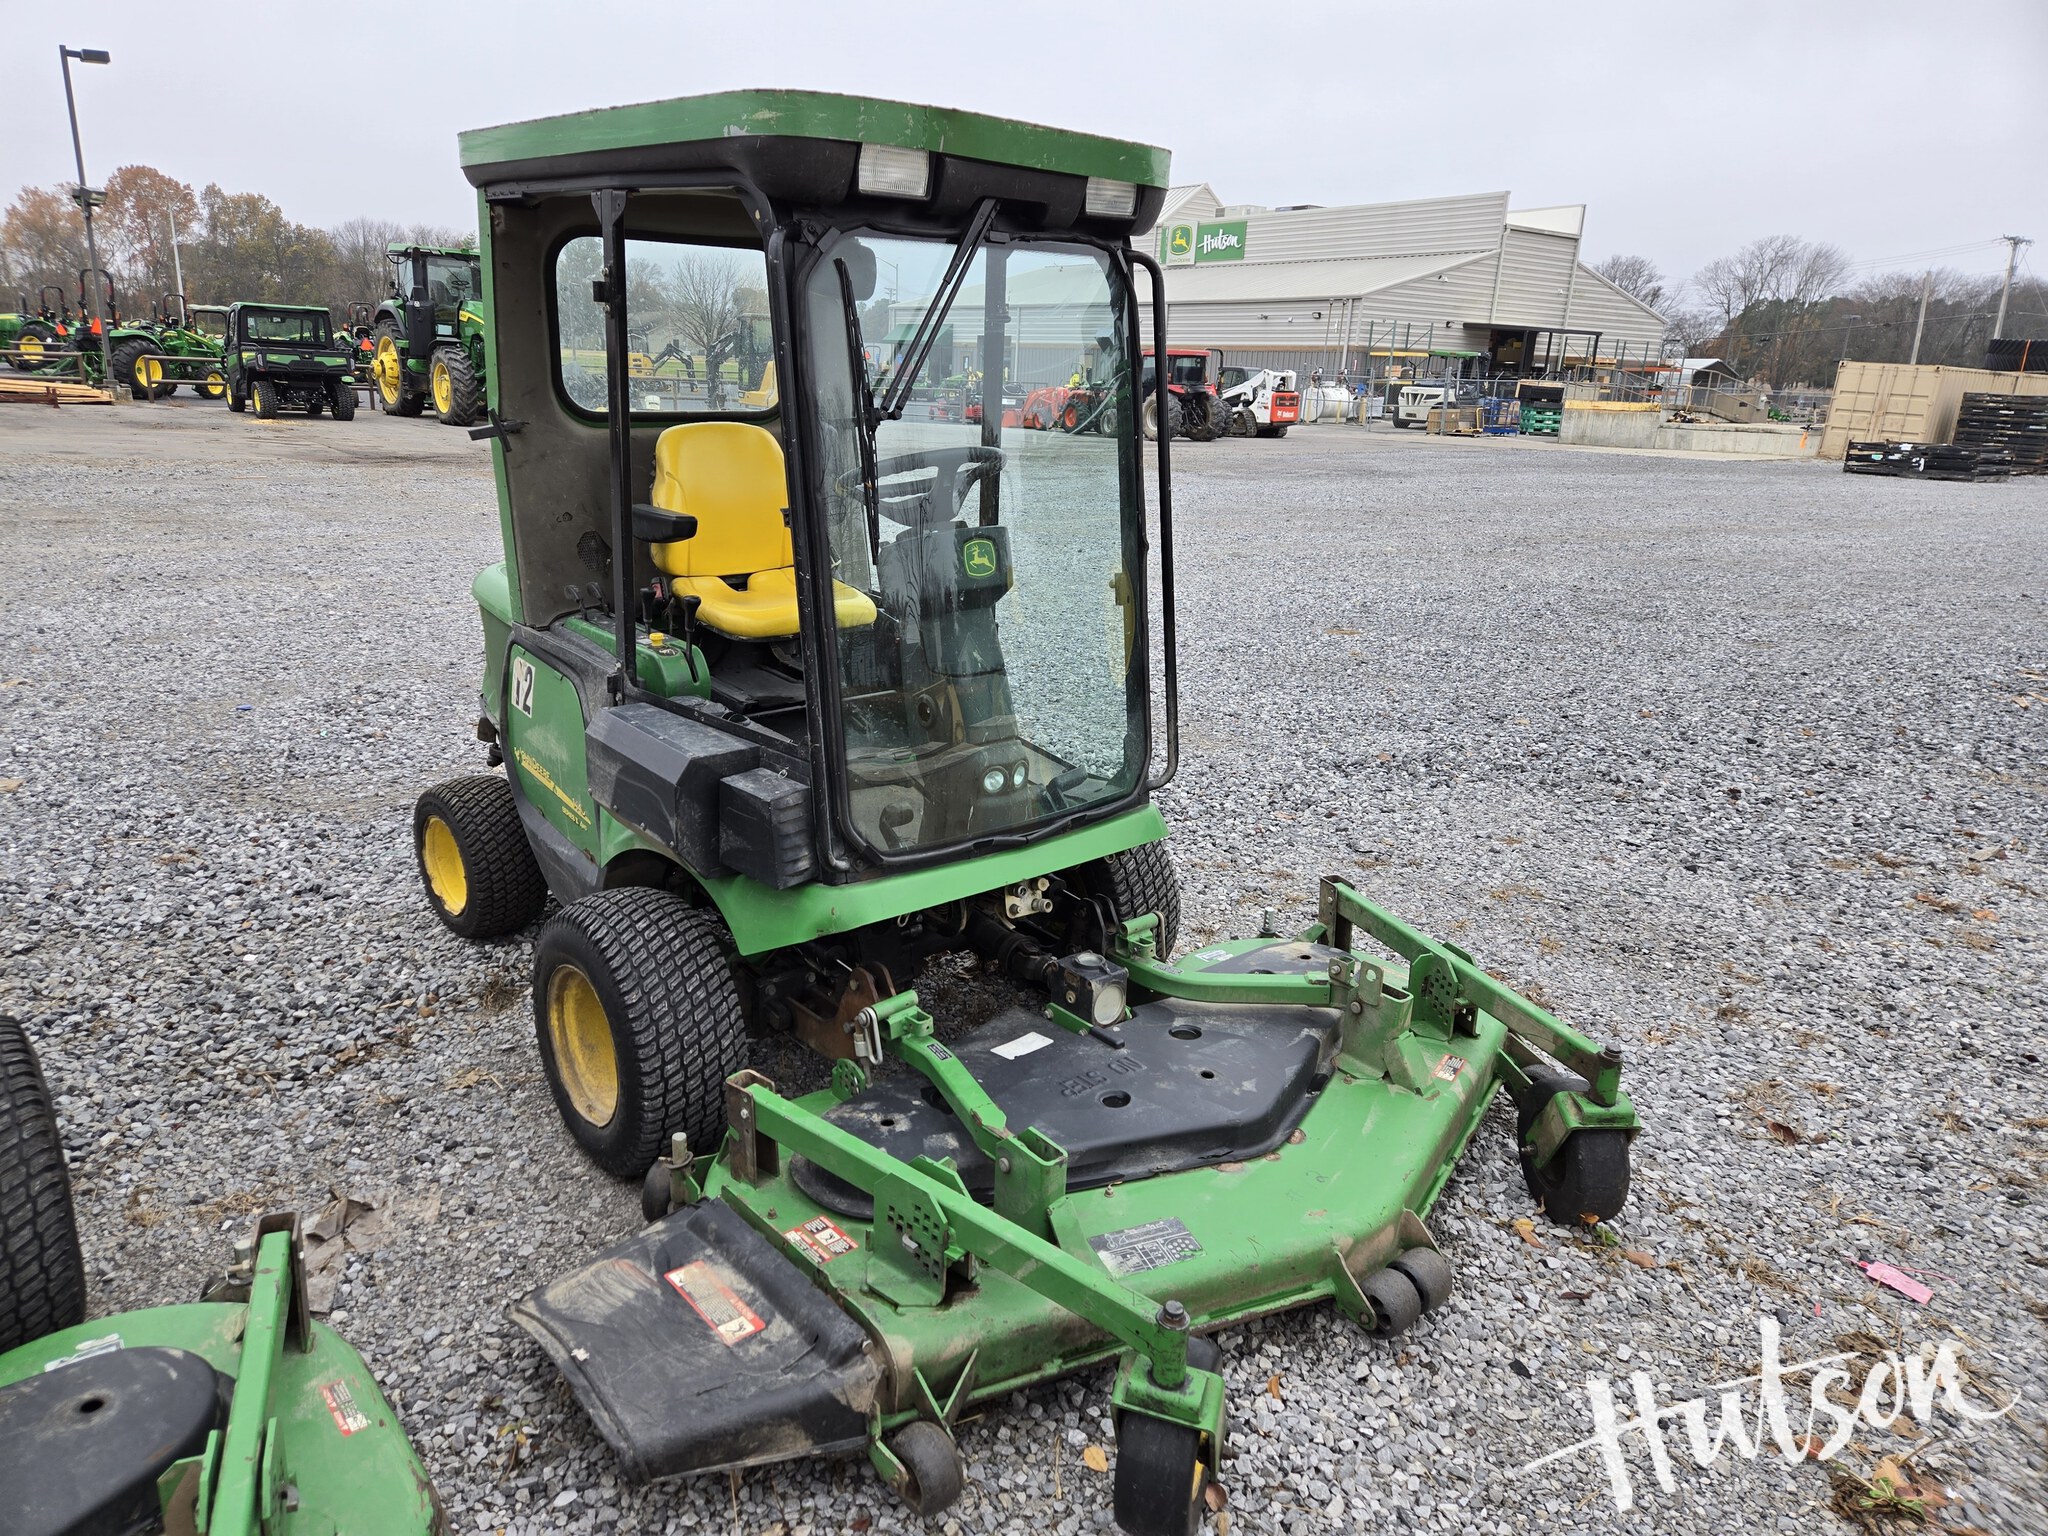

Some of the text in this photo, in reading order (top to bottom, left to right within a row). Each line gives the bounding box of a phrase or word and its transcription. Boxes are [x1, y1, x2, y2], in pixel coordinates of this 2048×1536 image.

[1197, 228, 1242, 254] Hutson
[1059, 1056, 1148, 1098] NO STEP
